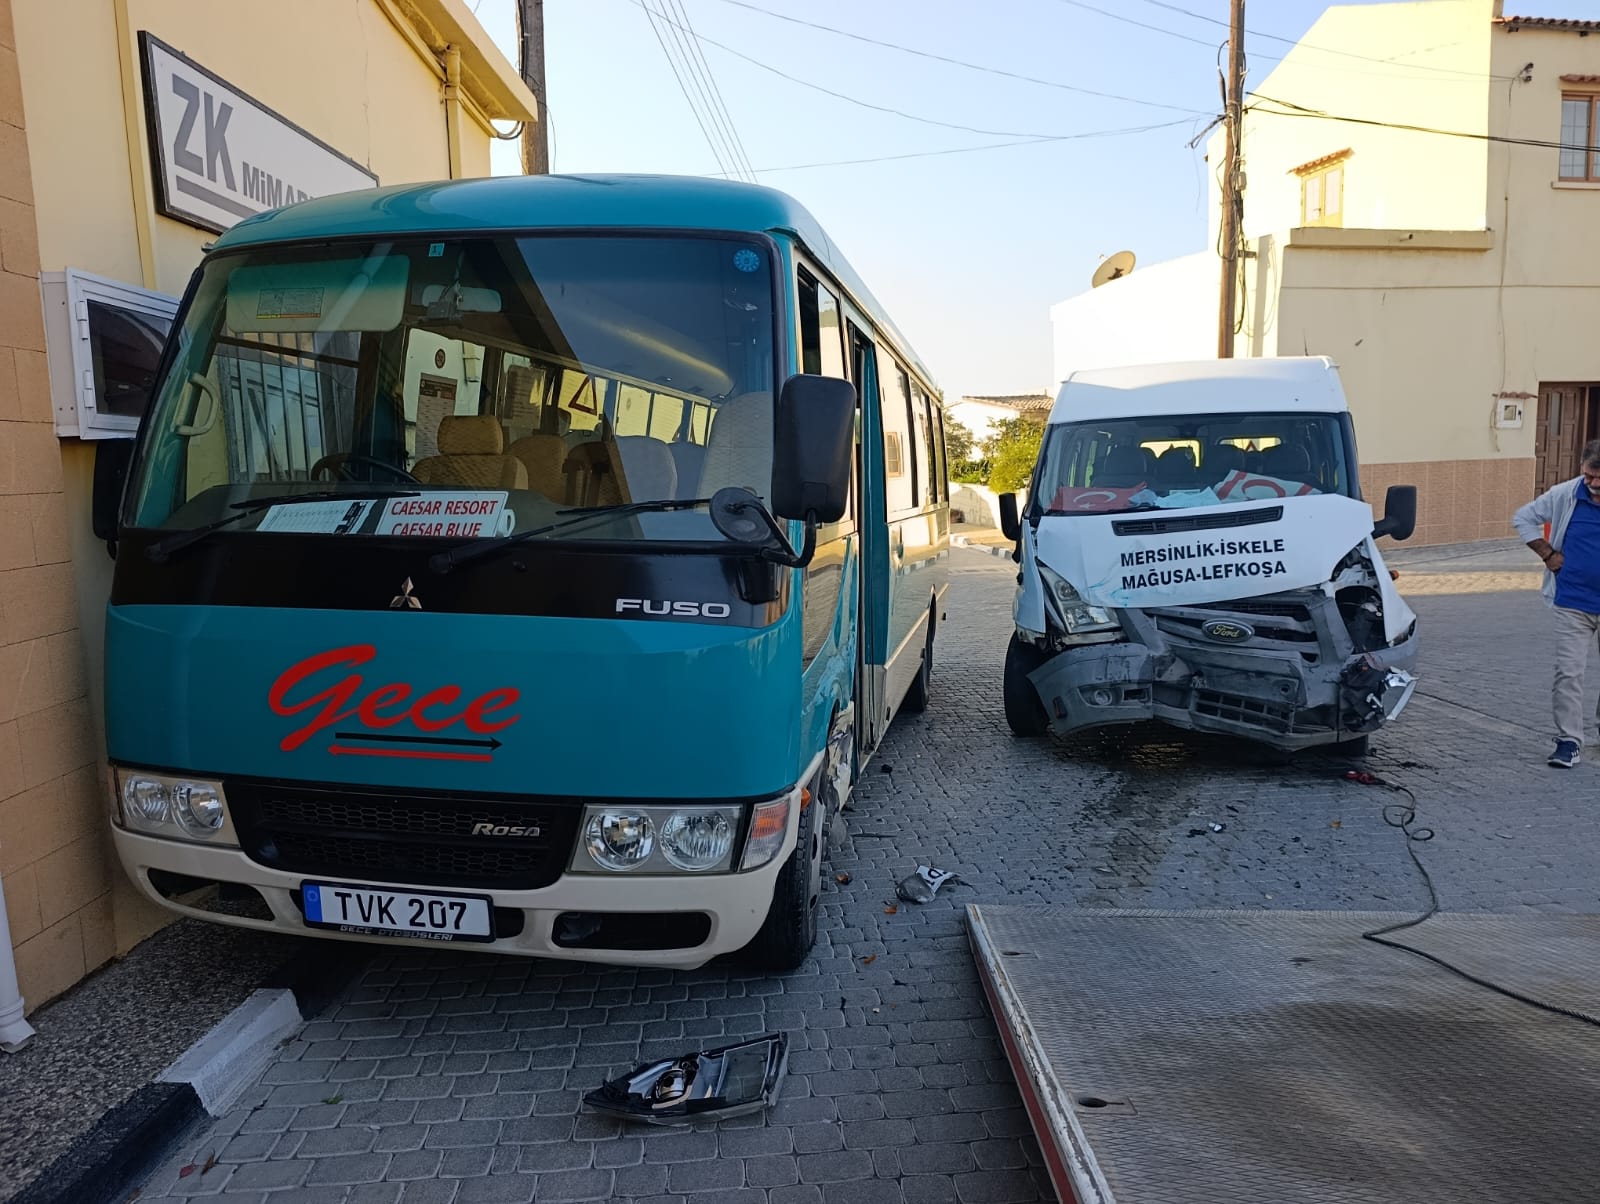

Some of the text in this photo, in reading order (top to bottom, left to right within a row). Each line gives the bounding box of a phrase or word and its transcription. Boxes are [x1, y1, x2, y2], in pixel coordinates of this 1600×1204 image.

[172, 72, 237, 193] ZK
[391, 500, 499, 516] CAESAR RESORT
[391, 522, 482, 537] CAESAR BLUE
[1121, 560, 1287, 590] MAĞUSA-LEFKOŞA
[615, 598, 731, 618] FUSO
[1212, 624, 1241, 638] Ford
[268, 643, 521, 752] Gece
[334, 891, 467, 931] TVK 207
